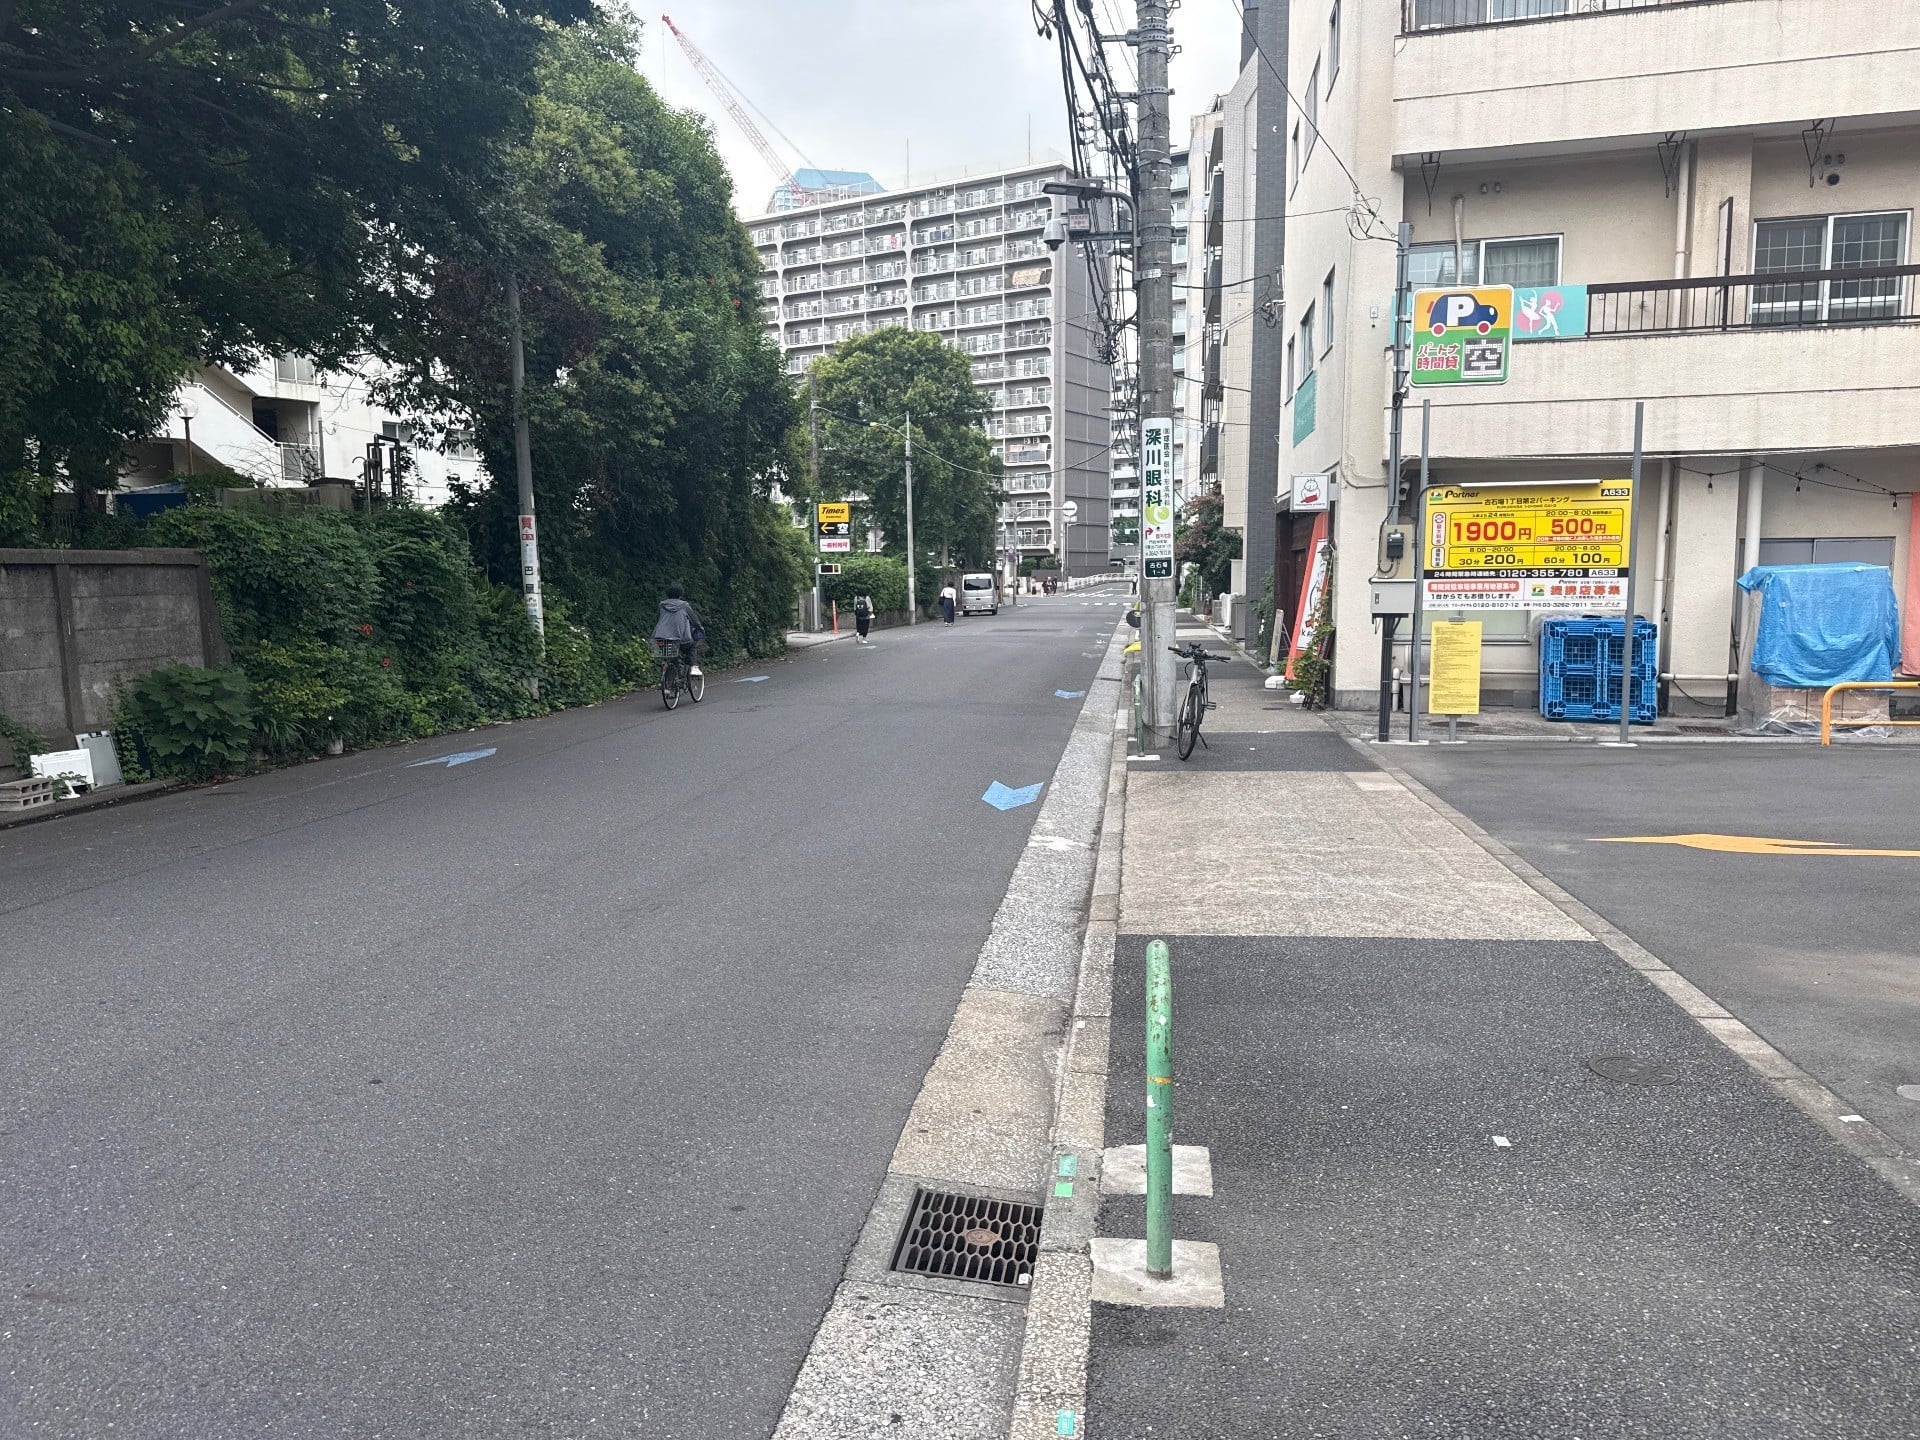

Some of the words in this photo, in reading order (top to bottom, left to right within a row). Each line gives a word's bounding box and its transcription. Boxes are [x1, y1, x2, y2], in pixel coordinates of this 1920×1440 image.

[1447, 296, 1474, 326] P
[1417, 342, 1459, 356] パートナ
[1416, 356, 1459, 370] 時間貸
[1464, 340, 1503, 376] 空
[1145, 428, 1162, 508] 深川眼科
[1444, 490, 1480, 498] Partner
[837, 523, 848, 534] 空
[1454, 521, 1532, 541] 1900円
[1551, 518, 1606, 534] 500円
[1484, 554, 1524, 565] 200円
[1573, 553, 1610, 564] 100円
[1550, 585, 1620, 596] 提携店募集
